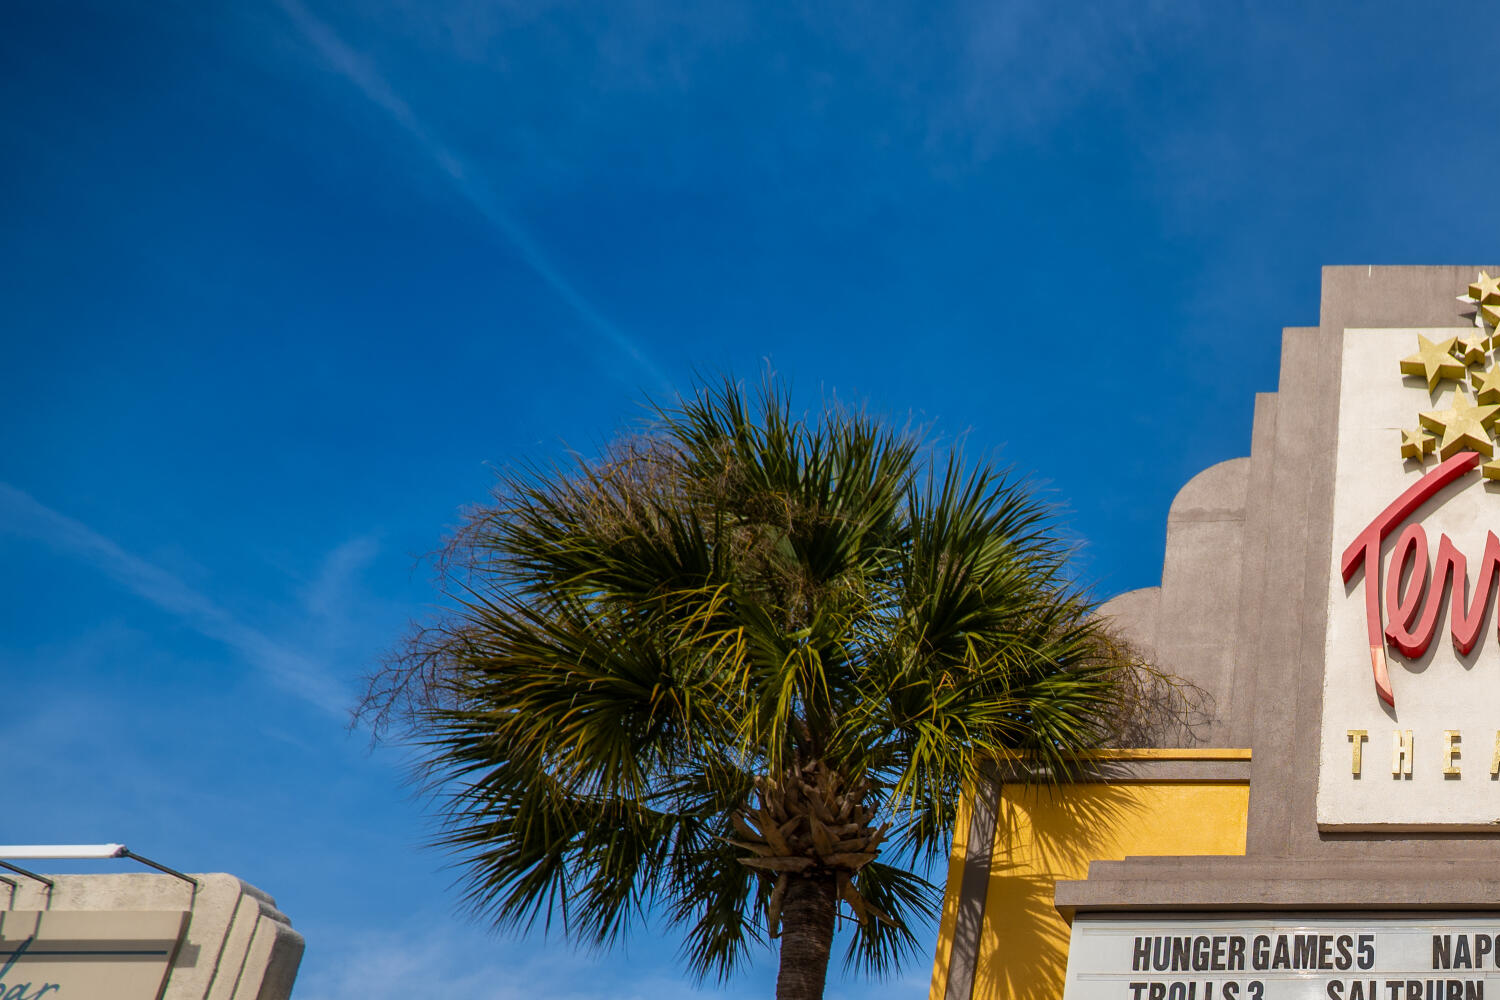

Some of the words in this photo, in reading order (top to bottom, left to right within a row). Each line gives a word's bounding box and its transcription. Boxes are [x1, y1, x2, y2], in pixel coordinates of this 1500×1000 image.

[1132, 934, 1246, 972] HUNGER
[1252, 934, 1354, 971] GAMES
[1357, 934, 1375, 970] 5
